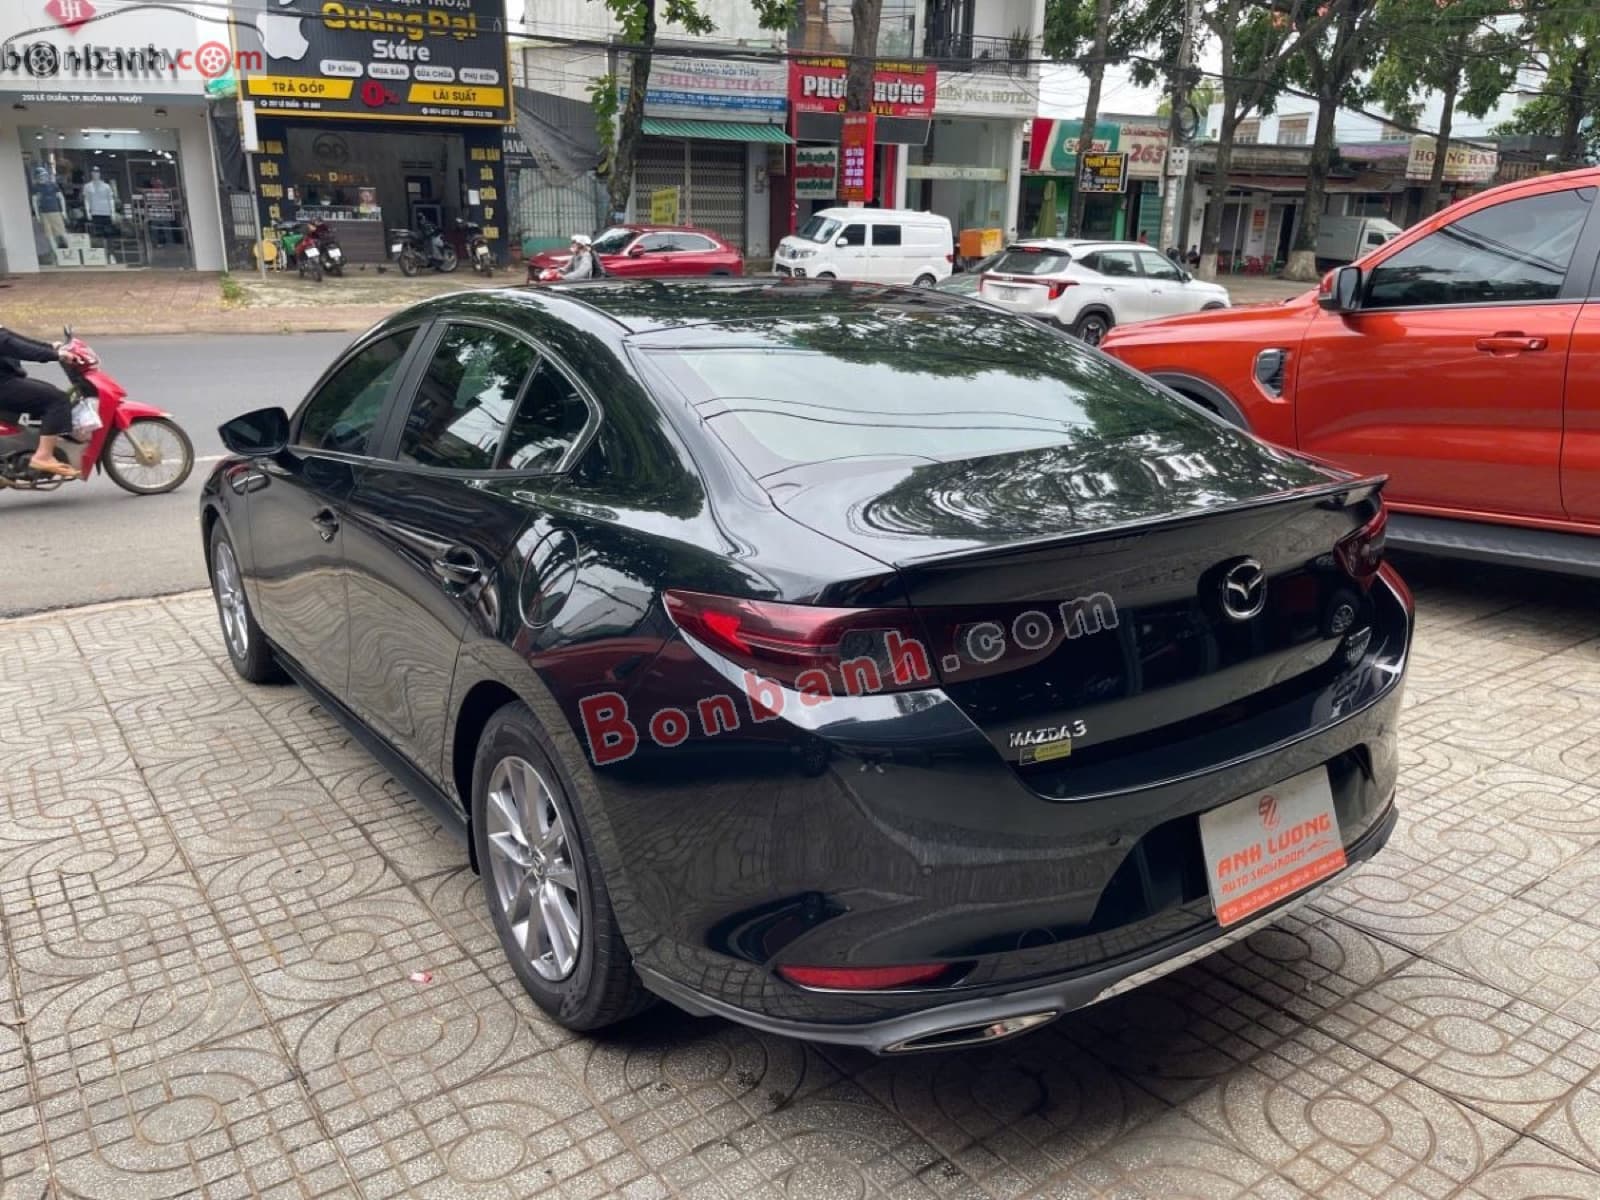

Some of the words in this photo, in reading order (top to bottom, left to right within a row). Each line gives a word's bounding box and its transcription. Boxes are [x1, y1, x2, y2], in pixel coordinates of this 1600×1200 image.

[272, 80, 296, 94] TRẢ
[299, 81, 325, 95] GÓP
[1130, 143, 1164, 163] 263
[1217, 843, 1262, 879] ANH
